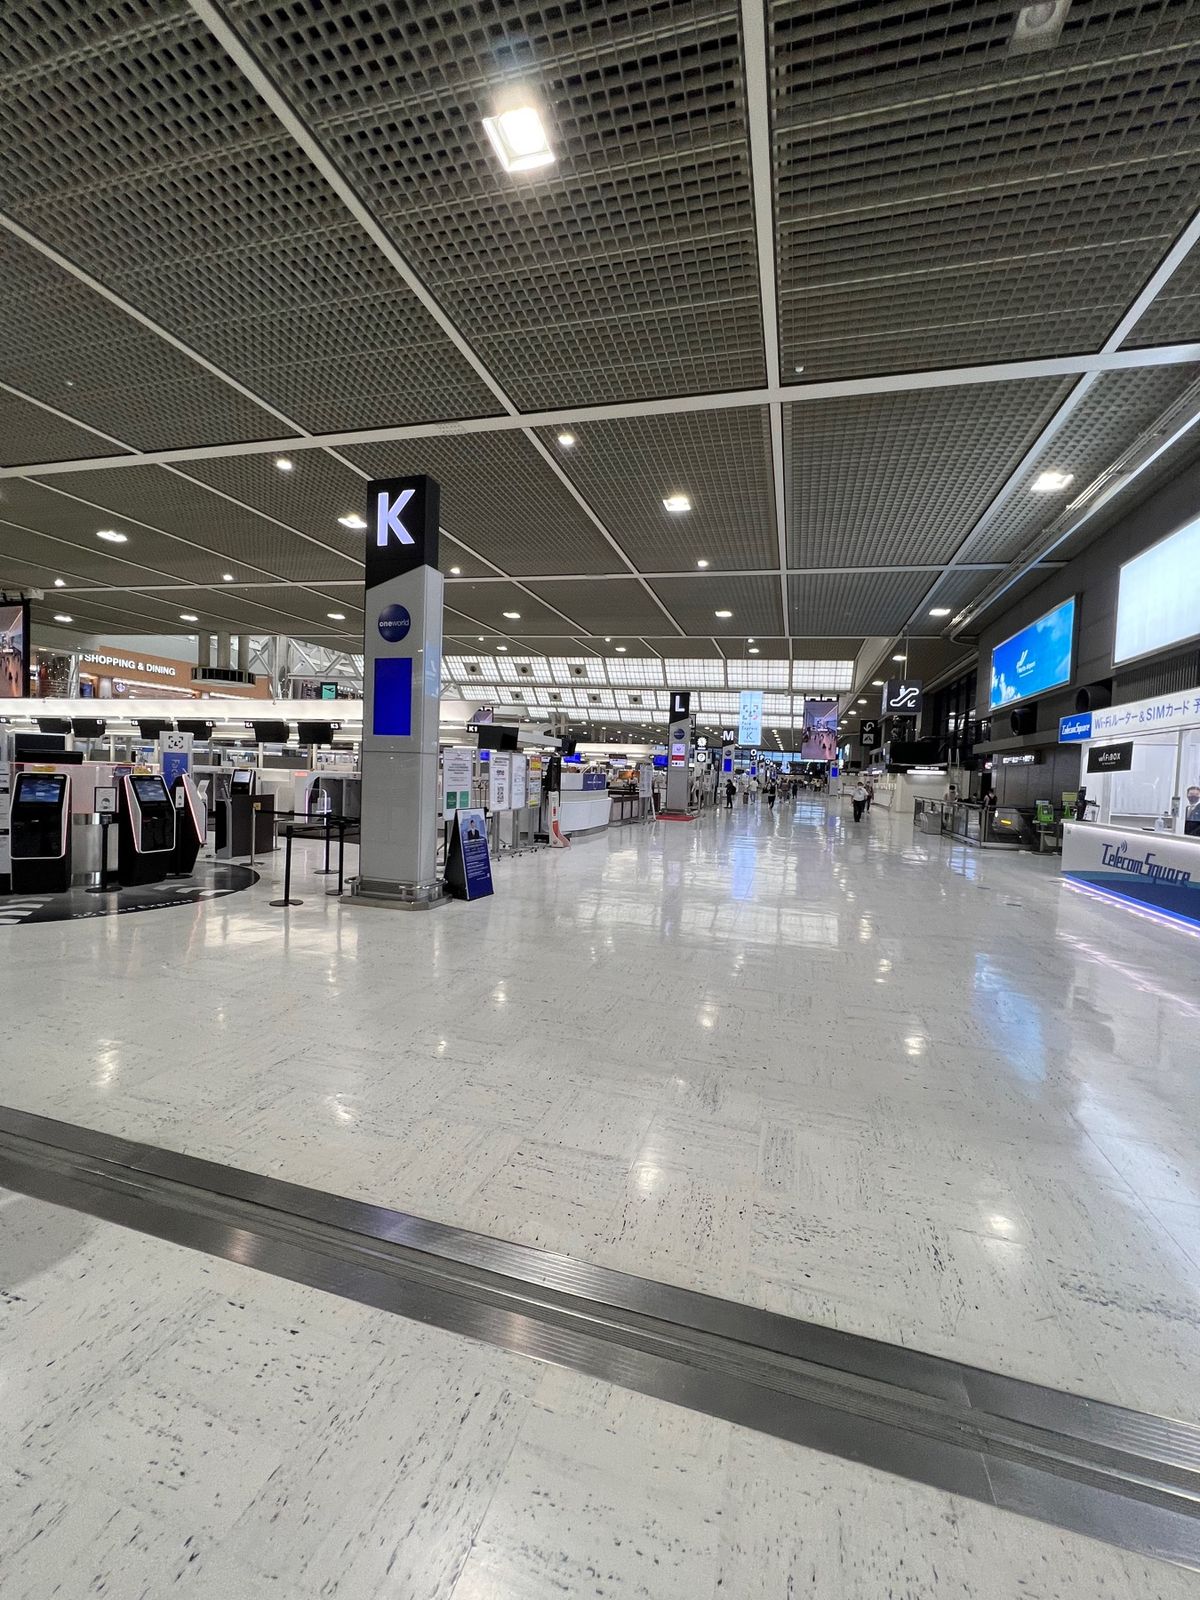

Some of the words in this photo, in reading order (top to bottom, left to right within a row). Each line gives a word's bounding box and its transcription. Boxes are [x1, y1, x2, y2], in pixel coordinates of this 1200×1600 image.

[377, 489, 416, 547] K
[379, 619, 410, 628] oneworld
[84, 654, 136, 669] SHOPPING
[137, 662, 145, 671] &
[146, 663, 176, 676] DINING
[675, 695, 686, 712] L
[722, 730, 734, 741] M
